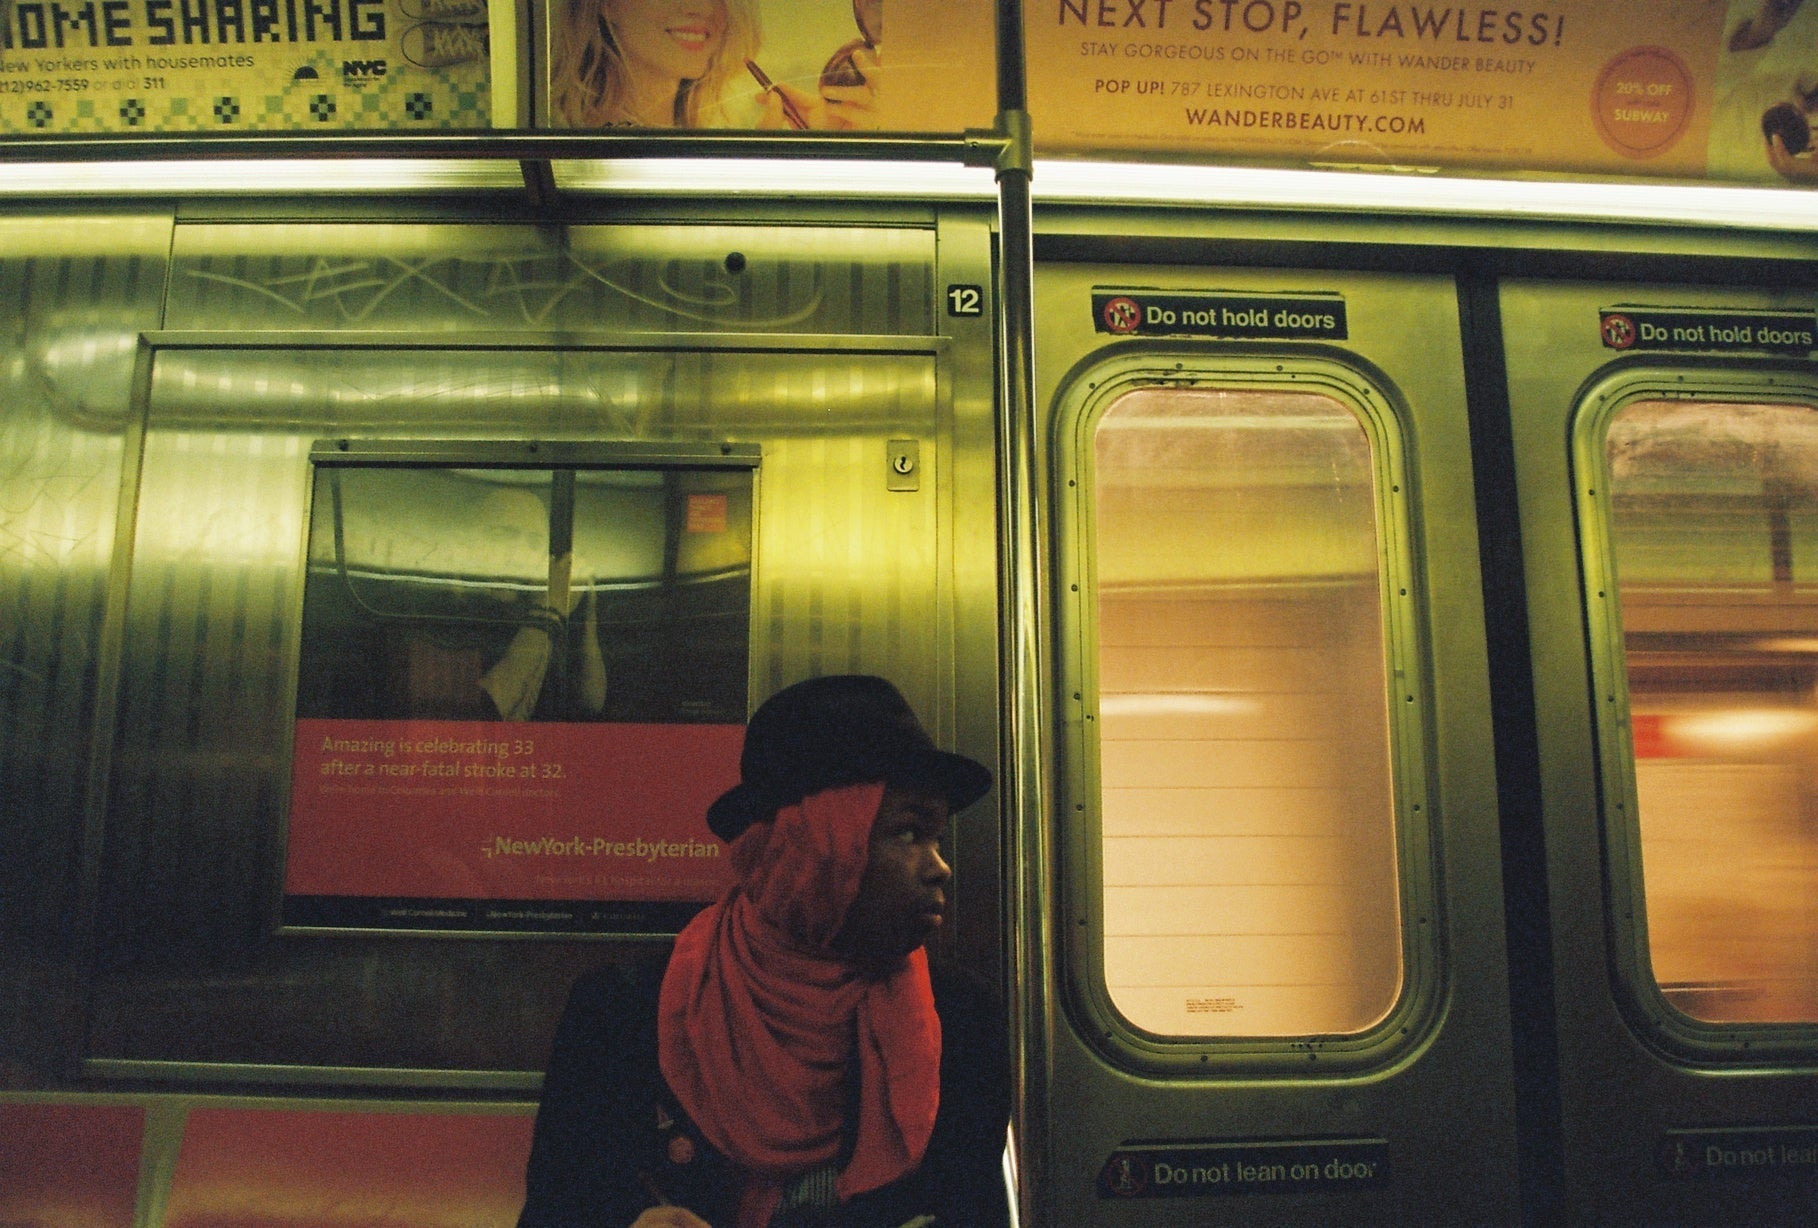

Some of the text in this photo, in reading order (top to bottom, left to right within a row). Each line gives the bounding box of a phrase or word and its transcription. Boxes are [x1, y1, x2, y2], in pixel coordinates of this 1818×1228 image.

[147, 0, 387, 46] SHARING
[1058, 0, 1565, 46] NEXT STOP, FLAWLESS!
[35, 58, 98, 72] Yorkers
[103, 55, 141, 70] with
[146, 54, 255, 69] housemates
[343, 60, 387, 75] NYC
[1081, 42, 1118, 58] STAY
[1124, 43, 1226, 61] GORGEOUS
[1231, 48, 1261, 62] ON
[1266, 48, 1297, 64] THE
[1350, 52, 1392, 67] WITH
[1399, 55, 1469, 71] WANDER
[1475, 57, 1536, 73] BEAUTY
[143, 77, 165, 90] 311
[1095, 79, 1514, 109] POP UP! 787 LEXINGTON AVE AT 61ST THRU JULY 31
[1616, 82, 1673, 97] 20% OFF
[1185, 107, 1426, 134] WANDERBEAUTY.COM
[1613, 108, 1671, 124] SUBWAY
[949, 288, 980, 314] 12
[1147, 306, 1336, 329] Do not hold doors
[1640, 323, 1813, 346] Do not hold doors
[321, 736, 535, 759] Amazing is celebrating 33
[320, 758, 567, 779] after a near-fatal stroke at 32.
[495, 835, 720, 862] NewYork-Presbyterian
[1706, 1145, 1737, 1166] Do
[1740, 1146, 1776, 1166] not
[1154, 1162, 1187, 1185] Do
[1192, 1164, 1228, 1183] not
[1237, 1161, 1285, 1182] lean
[1290, 1161, 1319, 1181] on
